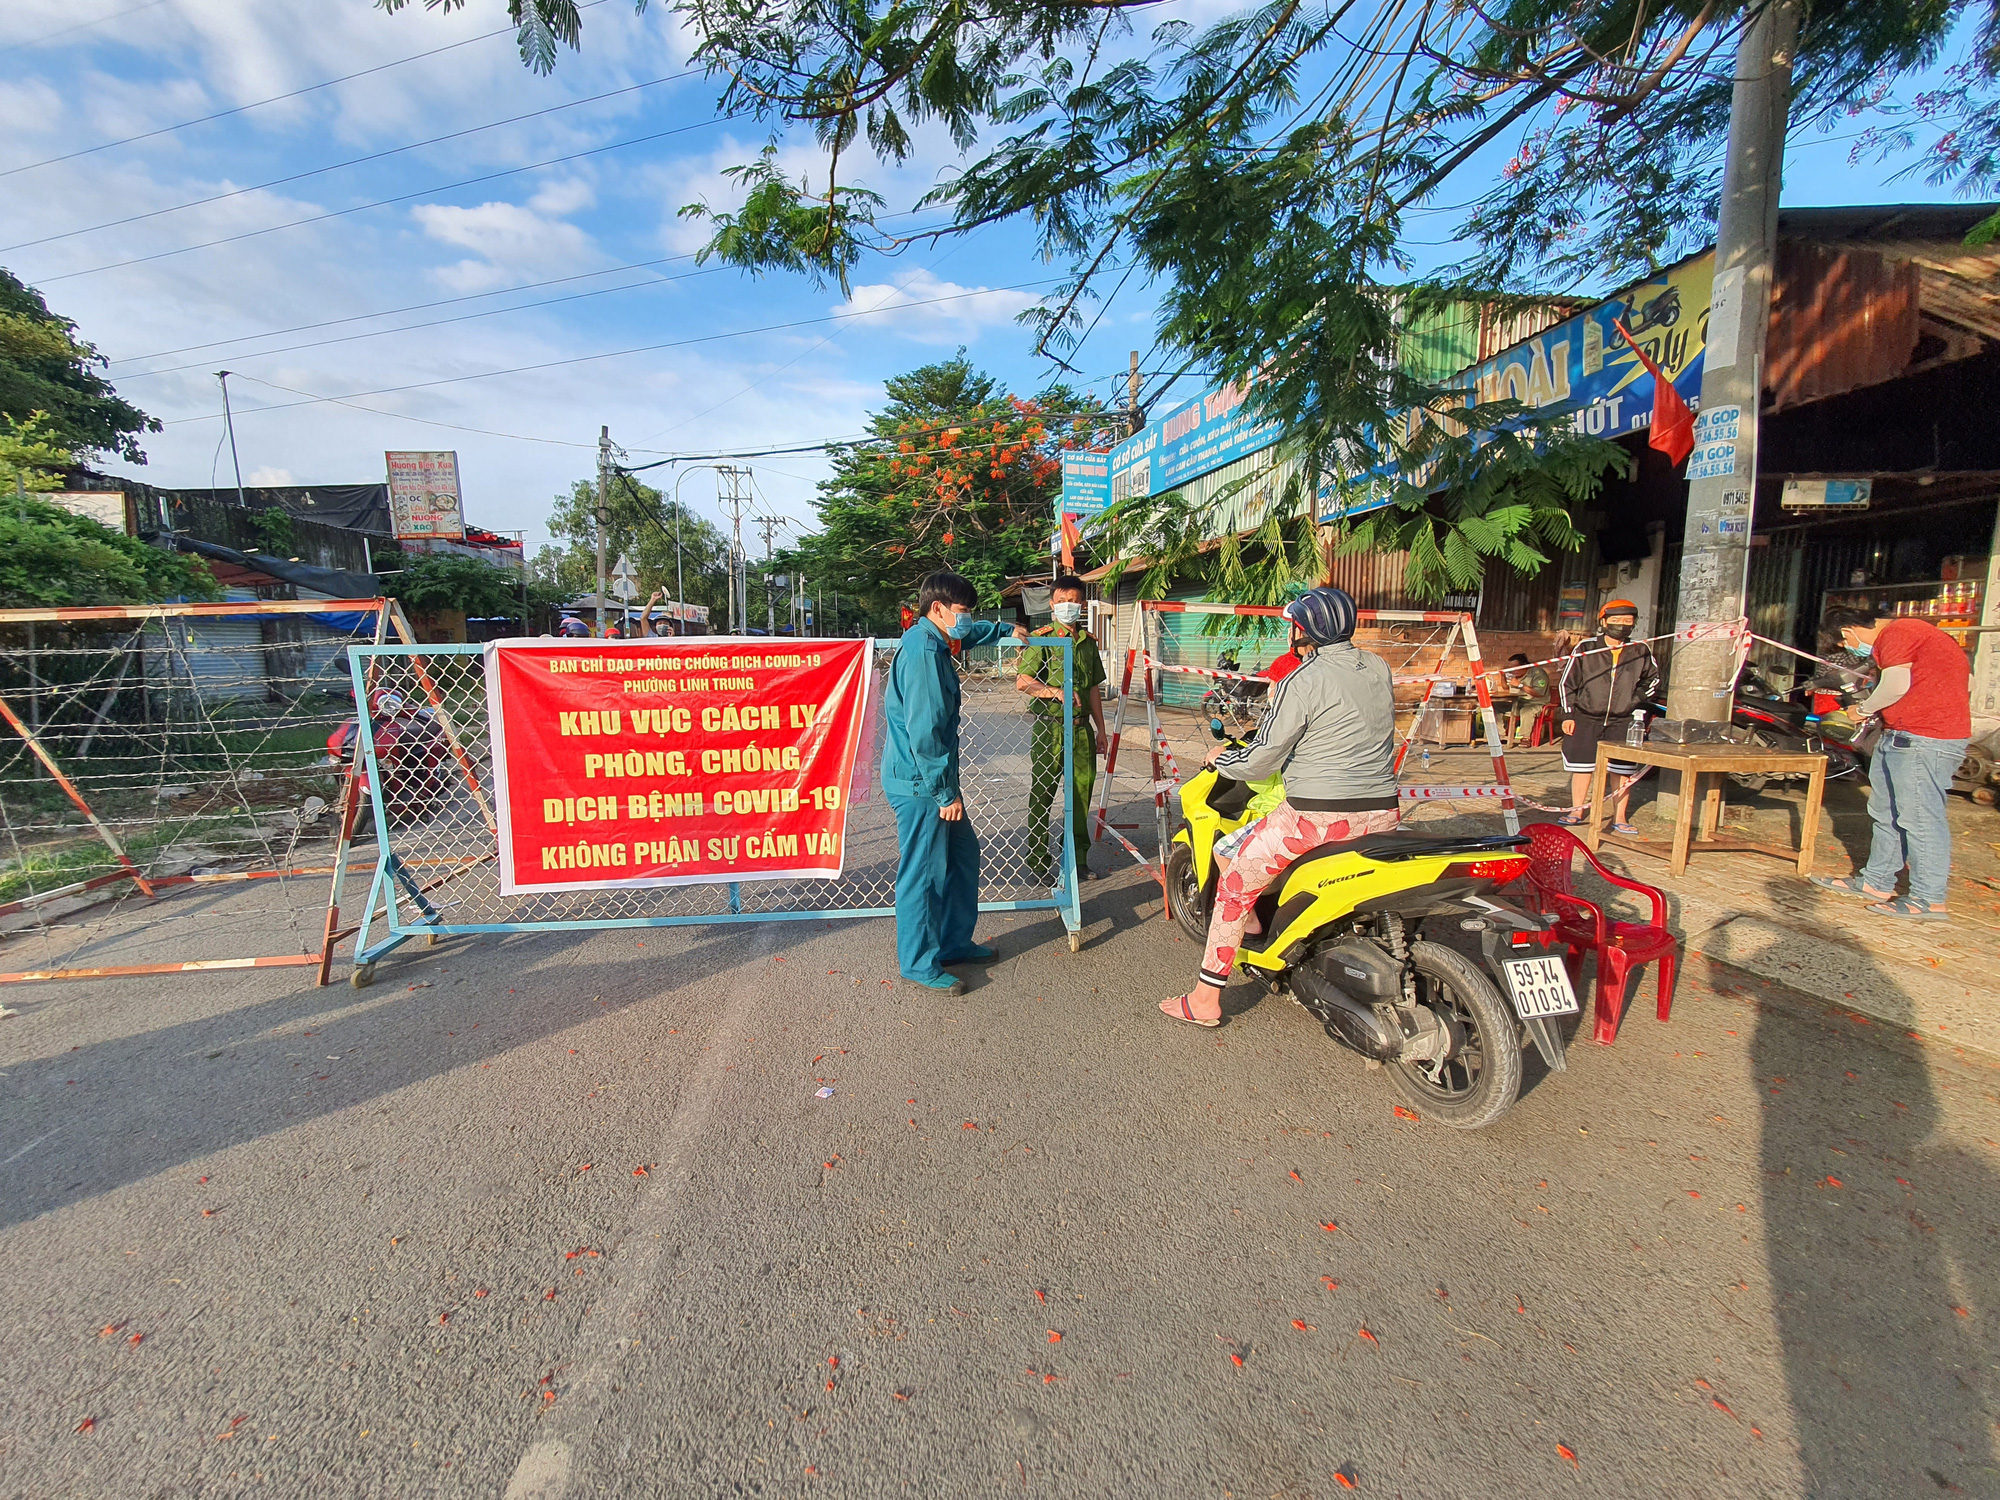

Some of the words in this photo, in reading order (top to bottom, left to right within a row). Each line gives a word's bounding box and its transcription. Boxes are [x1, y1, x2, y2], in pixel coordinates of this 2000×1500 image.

[550, 659, 579, 673] BAN
[581, 655, 603, 672] CHỈ
[607, 658, 635, 675] ĐẠO
[637, 654, 682, 671] PHÒNG
[685, 652, 729, 671] CHỐNG
[731, 655, 761, 674] DỊCH
[764, 653, 821, 670] COVID-19
[624, 676, 676, 693] PHƯỜNG
[680, 677, 708, 692] LINH
[712, 676, 754, 692] TRUNG
[559, 710, 621, 736] KHU
[631, 706, 692, 738] VỰC
[702, 703, 780, 732] CÁCH
[789, 704, 817, 729] LY
[585, 745, 693, 778] PHÒNG,
[701, 740, 801, 774] CHỐNG
[544, 796, 618, 827] DỊCH
[628, 790, 703, 823] BỆNH
[714, 785, 841, 814] COVID-19
[541, 839, 627, 870] KHÔNG
[634, 836, 700, 868] PHẬN
[707, 835, 740, 866] SỰ
[745, 827, 798, 859] CẤM
[1513, 959, 1559, 987] 59-X4
[1518, 985, 1572, 1015] 010.94
